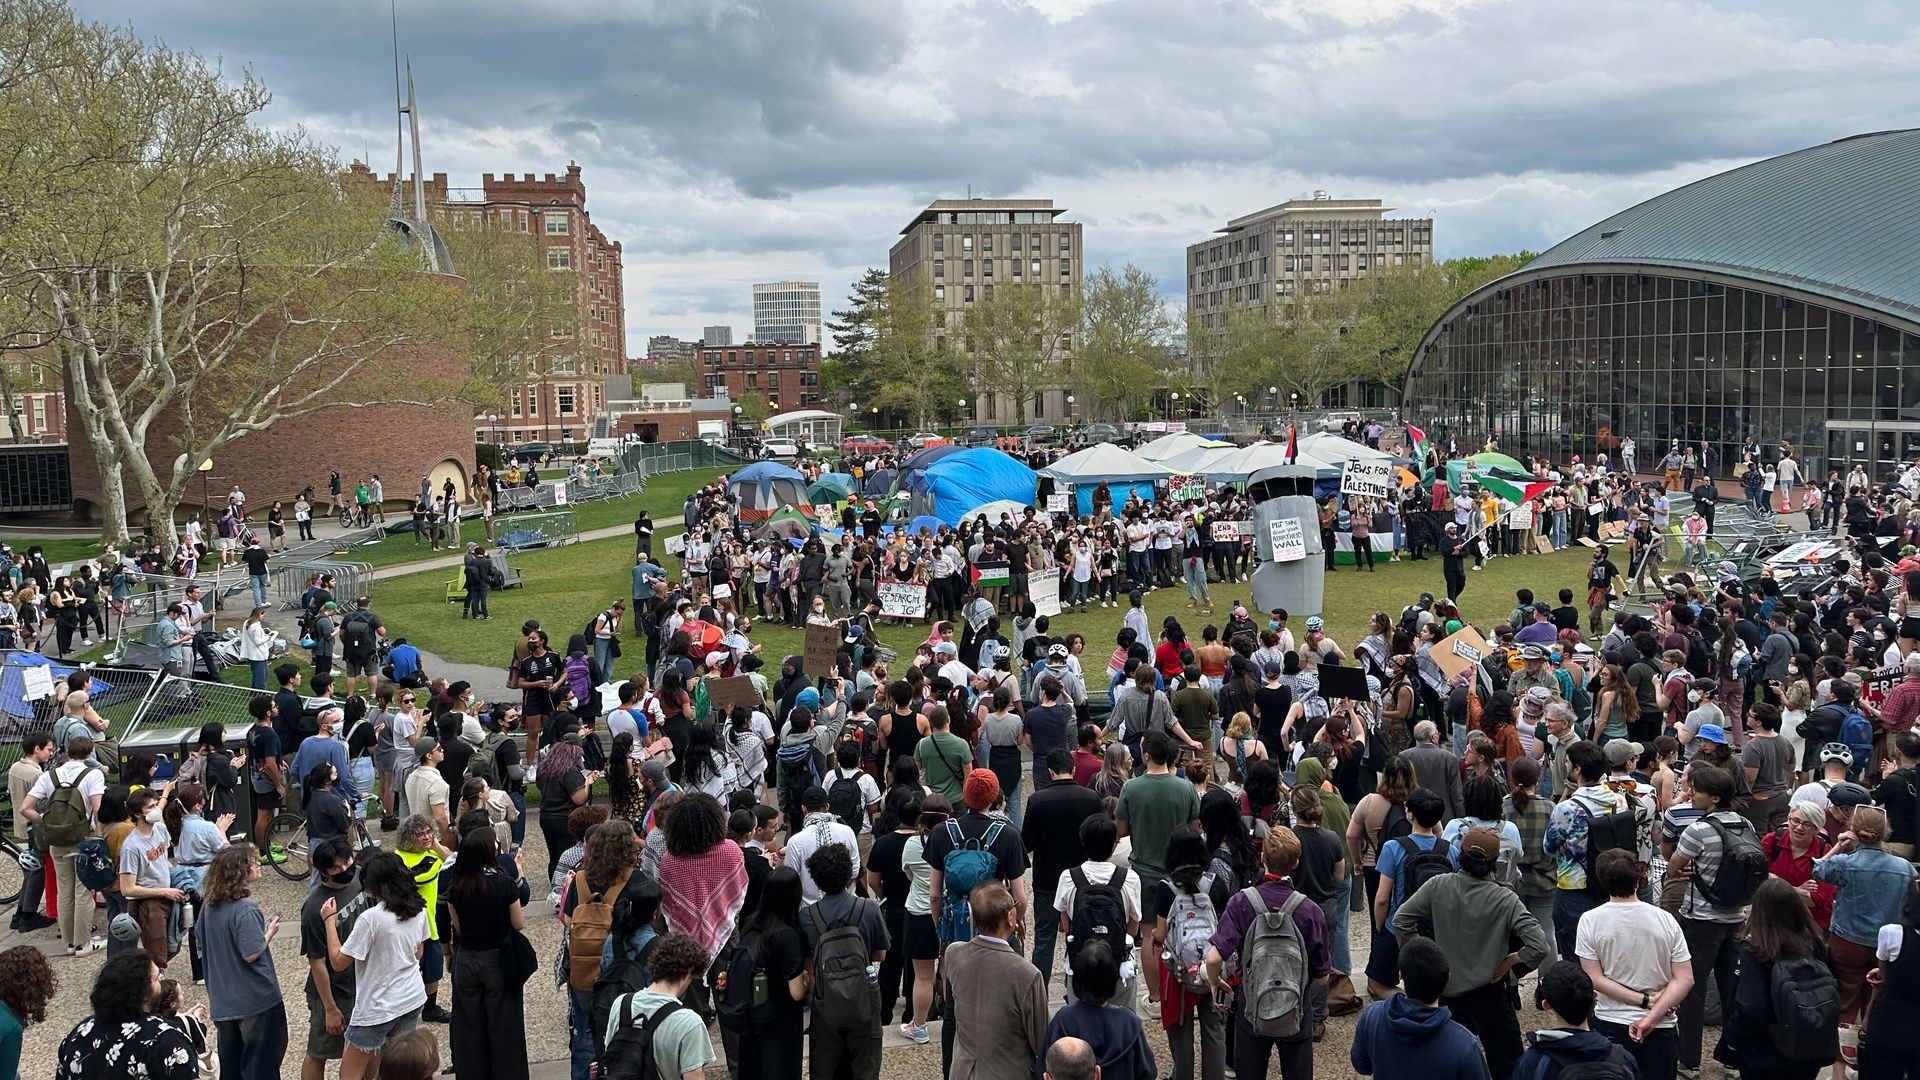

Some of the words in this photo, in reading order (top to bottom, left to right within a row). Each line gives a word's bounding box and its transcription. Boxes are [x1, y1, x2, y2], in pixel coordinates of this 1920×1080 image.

[1348, 459, 1371, 474] JEWS
[1375, 466, 1389, 475] FOR
[1344, 475, 1386, 496] PALESTINE
[1171, 488, 1206, 501] CHILDREN
[1274, 540, 1302, 549] WALL
[881, 584, 892, 592] NO
[880, 592, 920, 604] RESEARCH
[884, 604, 894, 613] OR
